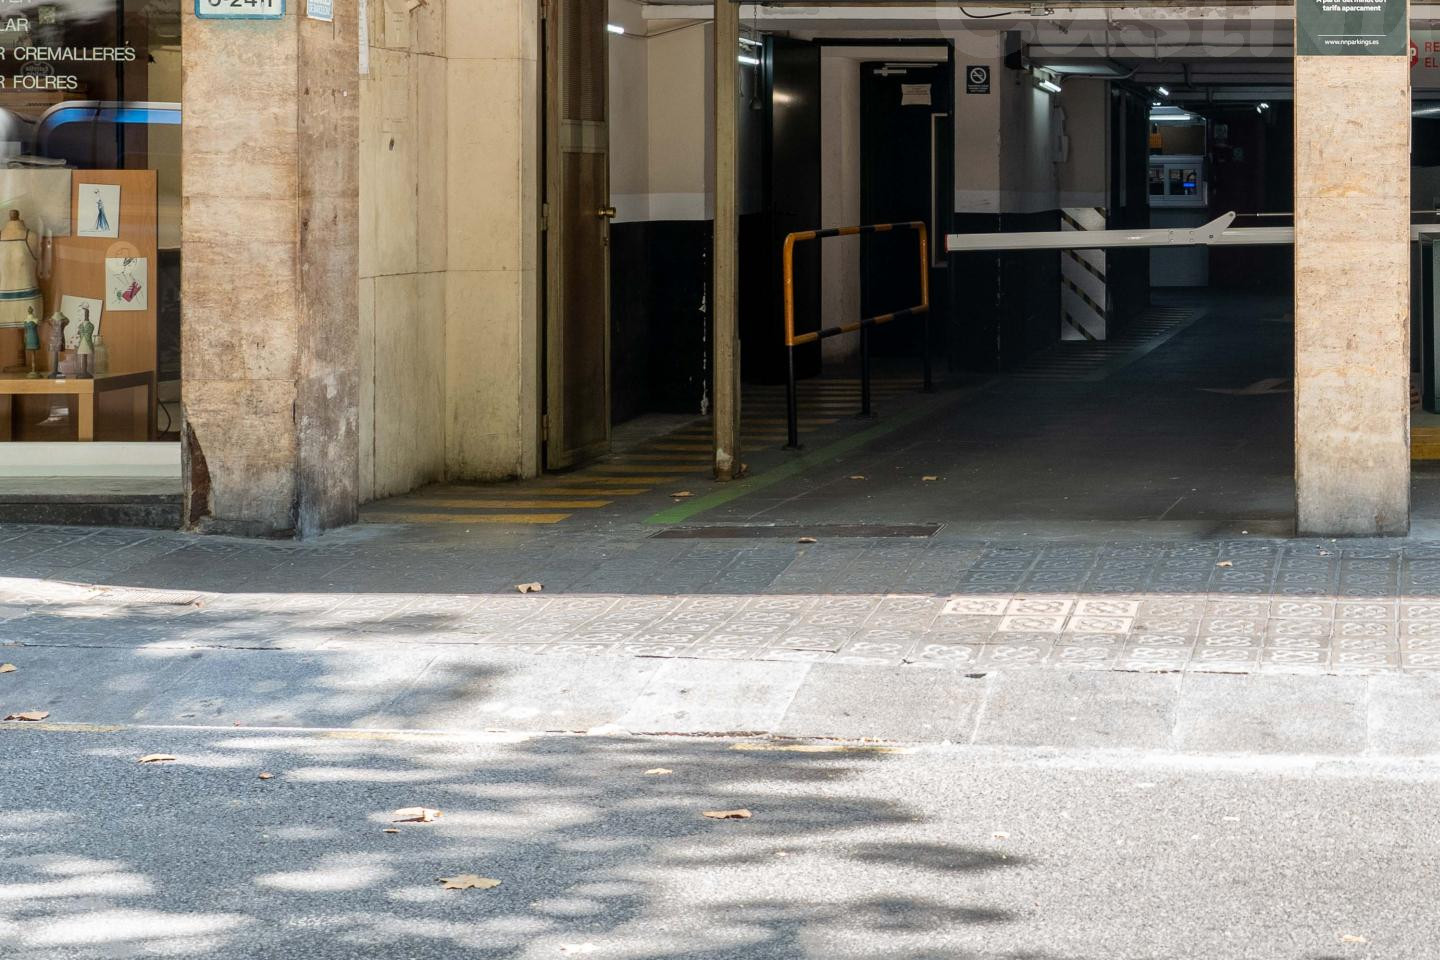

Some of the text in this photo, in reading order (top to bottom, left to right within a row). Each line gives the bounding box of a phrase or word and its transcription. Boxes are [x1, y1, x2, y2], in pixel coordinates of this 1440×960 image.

[0, 18, 28, 32] AR
[14, 47, 136, 61] CREMALLERES
[1424, 57, 1438, 68] EL
[13, 75, 78, 89] FOLRES
